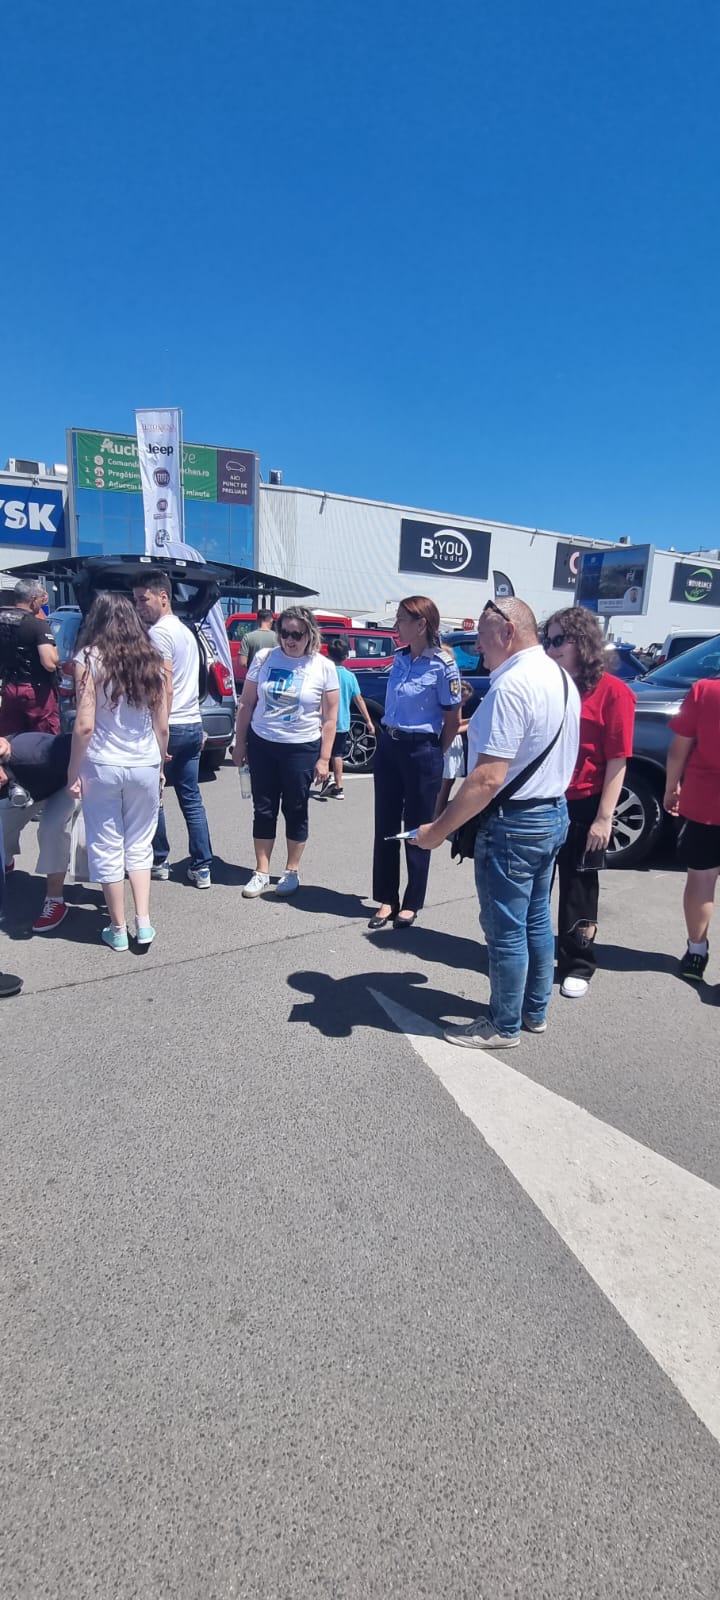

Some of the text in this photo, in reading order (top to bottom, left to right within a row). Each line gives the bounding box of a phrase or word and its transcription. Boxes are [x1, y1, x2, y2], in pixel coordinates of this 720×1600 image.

[100, 438, 140, 456] Auch
[146, 443, 174, 456] Jeep
[420, 537, 464, 558] B'YOU
[434, 553, 463, 563] studio
